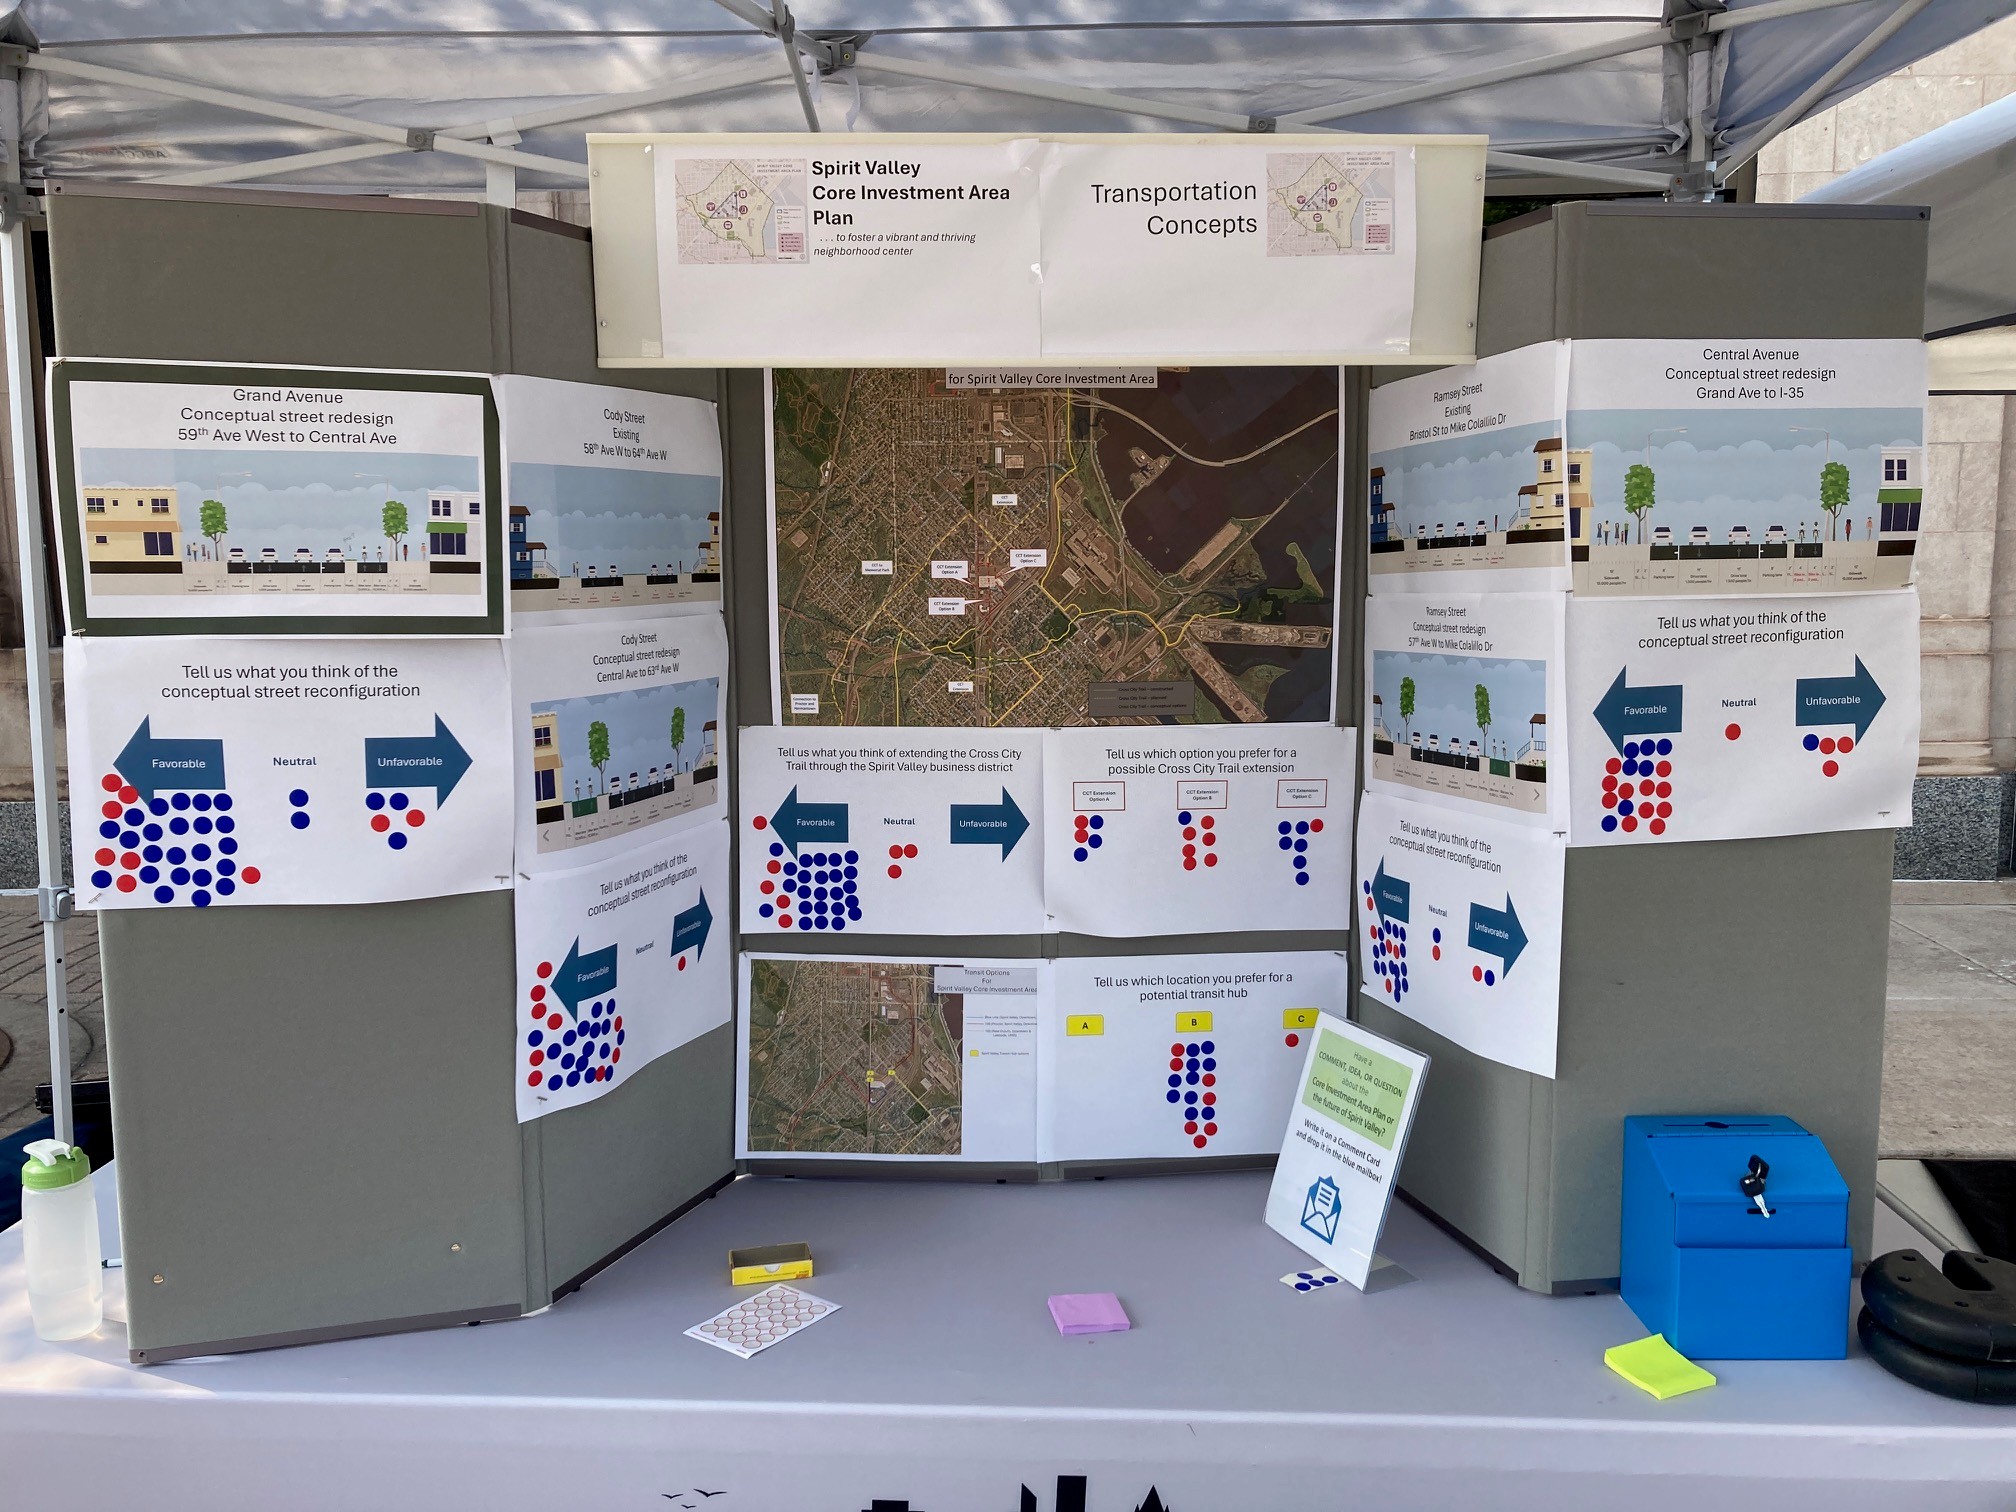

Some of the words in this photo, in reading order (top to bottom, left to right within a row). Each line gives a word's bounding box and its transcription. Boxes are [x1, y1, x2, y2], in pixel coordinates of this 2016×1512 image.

[812, 160, 860, 178] Spirit
[864, 160, 920, 178] Valley
[812, 185, 855, 200] Core
[861, 184, 964, 199] Investment
[968, 184, 1009, 199] Area
[1090, 180, 1256, 206] Transportation
[813, 210, 852, 225] Plan
[1147, 215, 1257, 238] Concepts
[836, 233, 846, 241] to
[848, 232, 876, 242] foster
[877, 234, 883, 242] a
[885, 232, 918, 242] vibrant
[920, 232, 939, 241] and
[941, 232, 976, 243] thriving
[813, 246, 880, 257] neighborhood
[882, 247, 913, 255] center
[1703, 348, 1749, 360] Central
[1752, 348, 1799, 360] Avenue
[948, 373, 964, 384] for
[967, 373, 996, 386] Spirit
[999, 373, 1032, 386] Valley
[1035, 373, 1061, 383] Core
[1065, 373, 1126, 383] Investment
[1129, 373, 1154, 384] Area
[1665, 367, 1739, 382] Conceptual
[1742, 368, 1779, 379] street
[1782, 367, 1835, 382] redesign
[233, 388, 281, 402] Grand
[285, 390, 343, 403] Avenue
[1433, 389, 1460, 402] Ramsey
[1461, 382, 1482, 396] Street
[1696, 386, 1734, 398] Grand
[1737, 386, 1760, 398] Ave
[1763, 388, 1776, 398] to
[1780, 386, 1804, 398] I-35
[180, 407, 275, 424] Conceptual
[279, 411, 324, 422] street
[328, 411, 393, 427] redesign
[603, 408, 623, 423] Cody
[624, 410, 645, 424] Street
[1444, 403, 1471, 417] Existing
[178, 427, 208, 440] 59th
[212, 428, 241, 441] Ave
[244, 429, 285, 442] West
[289, 431, 304, 442] to
[309, 430, 366, 443] Central
[369, 432, 396, 444] Ave
[612, 427, 640, 443] Existing
[583, 442, 599, 454] 58th
[600, 444, 614, 456] Ave
[614, 445, 623, 456] W
[624, 447, 631, 457] to
[632, 447, 645, 458] 64th
[646, 448, 658, 460] Ave
[659, 450, 667, 460] W
[181, 665, 210, 678] Tell
[213, 668, 232, 678] us
[235, 665, 276, 678] what
[279, 668, 307, 681] you
[311, 664, 350, 678] think
[354, 664, 369, 677] of
[372, 664, 397, 677] the
[161, 685, 250, 701] conceptual
[254, 685, 300, 698] street
[304, 683, 419, 700] reconfiguration
[273, 756, 316, 766] Neutral
[377, 756, 442, 766] Unfavorable
[777, 747, 794, 757] Tell
[797, 749, 809, 757] us
[811, 747, 836, 757] what
[838, 749, 856, 759] you
[859, 748, 884, 757] think
[886, 748, 896, 757] of
[898, 748, 948, 760] extending
[949, 748, 966, 758] the
[968, 748, 998, 758] Cross
[1001, 748, 1021, 760] City
[1105, 748, 1124, 759] Tell
[1127, 750, 1140, 759] us
[1142, 748, 1176, 758] which
[1179, 748, 1213, 761] option
[1216, 749, 1236, 760] you
[1238, 747, 1270, 760] prefer
[1272, 747, 1288, 757] for
[1290, 749, 1296, 757] a
[152, 758, 206, 768] Favorable
[785, 760, 807, 770] Trail
[808, 761, 847, 773] through
[849, 761, 866, 771] the
[868, 761, 894, 773] Spirit
[896, 761, 927, 773] Valley
[930, 762, 975, 772] business
[977, 762, 1013, 772] district
[1108, 763, 1155, 776] possible
[1157, 763, 1190, 773] Cross
[1193, 762, 1215, 775] City
[1217, 762, 1240, 773] Trail
[1242, 762, 1294, 773] extension
[1094, 976, 1113, 987] Tell
[1115, 978, 1128, 986] us
[1130, 975, 1163, 986] which
[1166, 975, 1210, 985] location
[1212, 975, 1231, 986] you
[1234, 972, 1266, 985] prefer
[1268, 972, 1283, 982] for
[1286, 973, 1292, 982] a
[1140, 989, 1188, 1003] potential
[1190, 989, 1225, 999] transit
[1227, 987, 1247, 998] hub
[1191, 1018, 1197, 1026] B
[1297, 1014, 1304, 1022] C
[1353, 1051, 1367, 1064] Have
[1318, 1050, 1347, 1072] COMMENT,
[1347, 1065, 1362, 1079] IDEA,
[1363, 1072, 1373, 1082] OR
[1373, 1077, 1402, 1097] QUESTION
[1341, 1077, 1358, 1091] about
[1358, 1085, 1369, 1096] the
[1312, 1076, 1325, 1089] Core
[1325, 1082, 1357, 1106] Investment
[1356, 1100, 1372, 1114] Area
[1372, 1106, 1386, 1121] Plan
[1386, 1116, 1394, 1124] or
[1312, 1092, 1322, 1104] the
[1322, 1097, 1340, 1113] future
[1340, 1108, 1348, 1117] of
[1346, 1110, 1363, 1126] Spirit
[1364, 1118, 1386, 1137] Valley?
[1304, 1118, 1319, 1133] Write
[1319, 1128, 1324, 1136] it
[1324, 1131, 1332, 1140] on
[1337, 1137, 1366, 1159] Comment
[1366, 1153, 1380, 1167] Card
[1295, 1129, 1307, 1140] and
[1306, 1135, 1319, 1148] drop
[1320, 1143, 1325, 1151] it
[1325, 1144, 1331, 1154] in
[1331, 1149, 1342, 1160] the
[1341, 1154, 1355, 1168] blue
[1355, 1164, 1382, 1183] mailbox!
